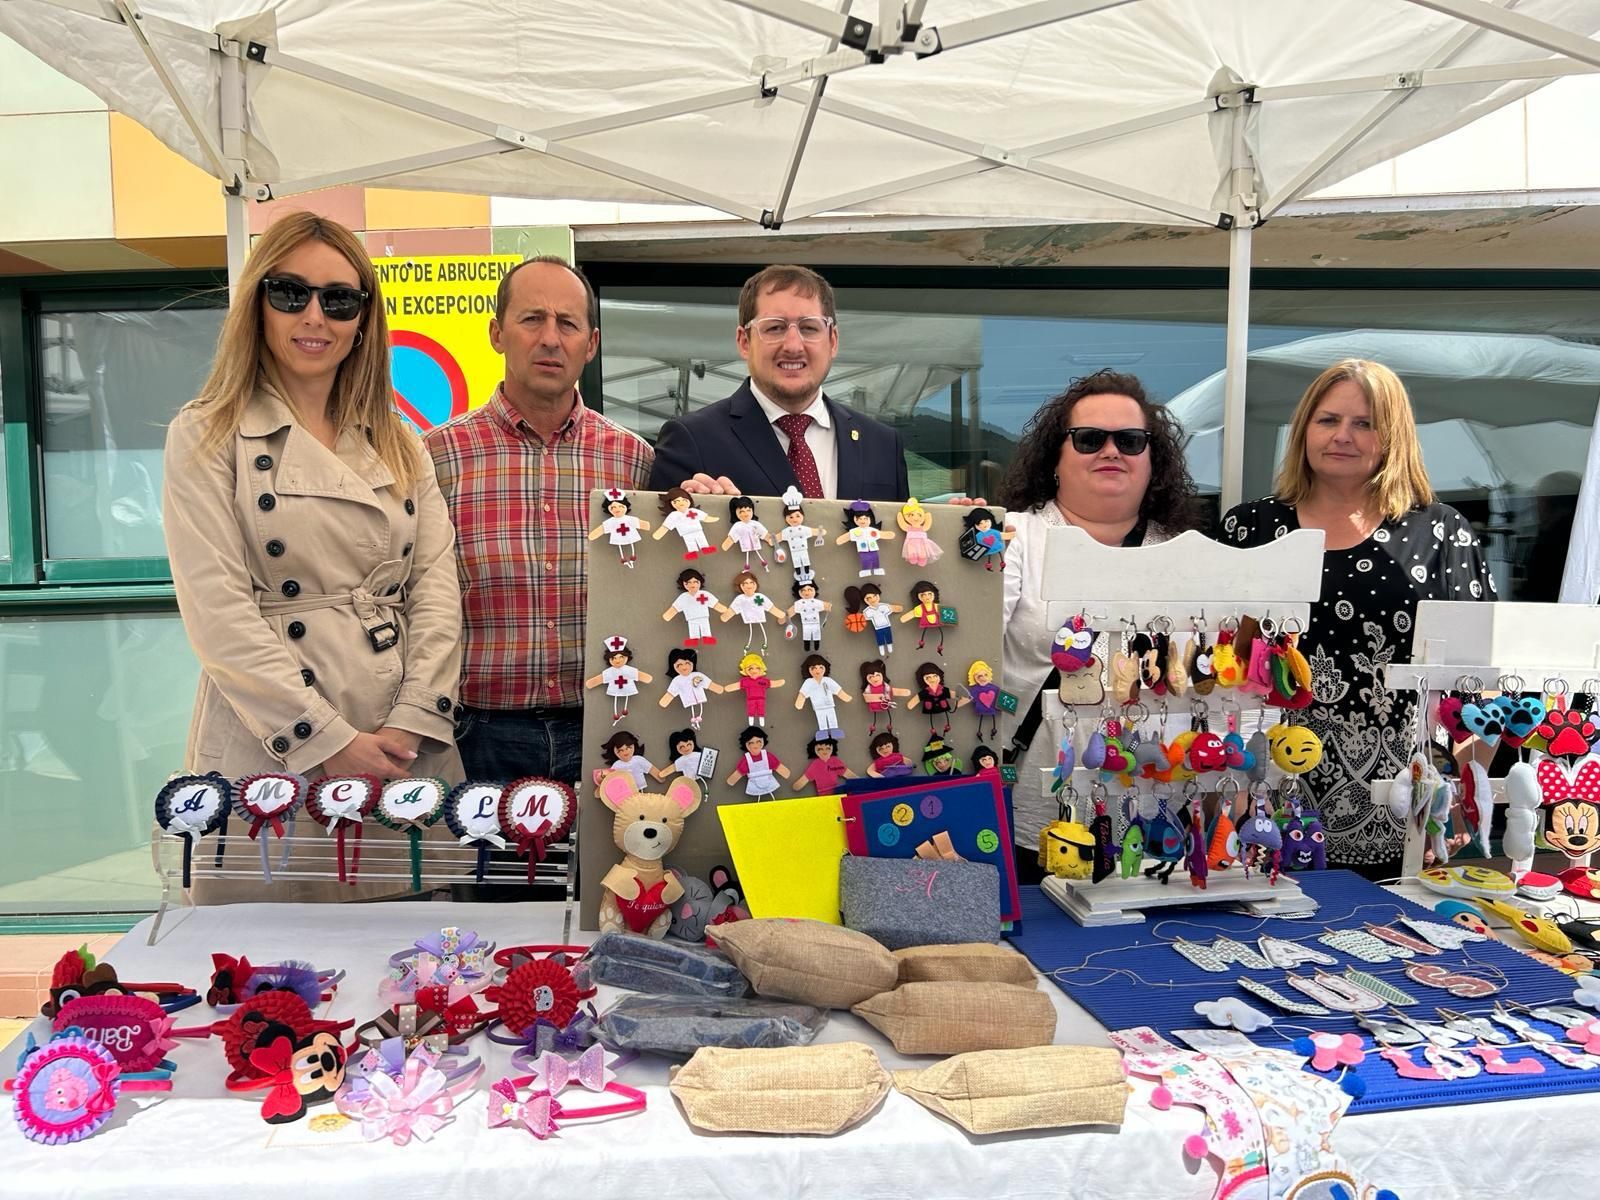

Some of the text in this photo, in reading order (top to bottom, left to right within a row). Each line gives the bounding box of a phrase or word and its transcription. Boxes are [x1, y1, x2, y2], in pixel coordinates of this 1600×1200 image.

[414, 263, 433, 282] DE
[403, 294, 497, 316] EXCEPCION
[175, 788, 208, 814] A
[250, 781, 286, 801] M
[331, 783, 353, 802] C
[394, 785, 425, 805] A
[472, 795, 495, 820] L
[516, 794, 551, 818] M
[896, 807, 909, 823] 2
[882, 827, 896, 843] 3
[981, 833, 995, 850] 5
[626, 900, 640, 910] Te
[82, 1024, 142, 1052] Barb
